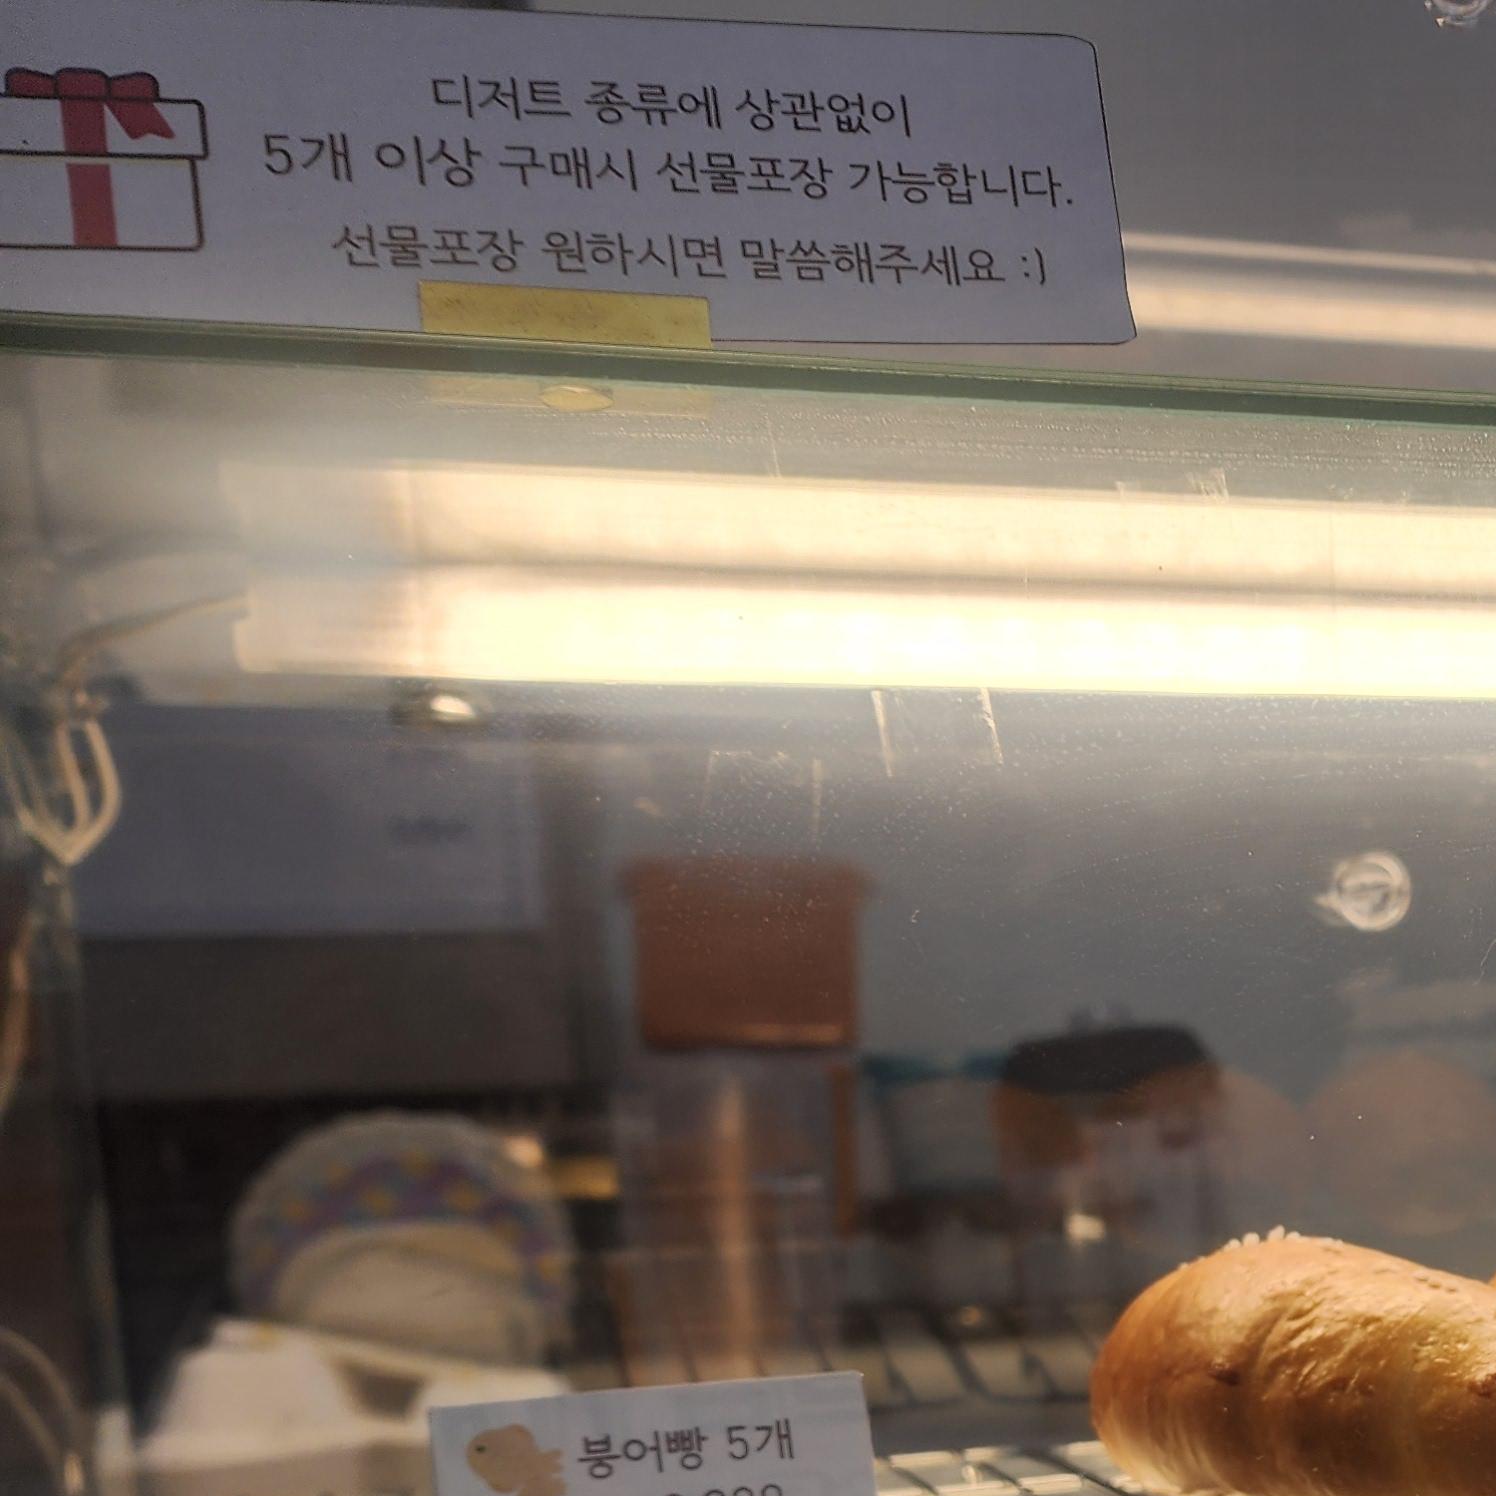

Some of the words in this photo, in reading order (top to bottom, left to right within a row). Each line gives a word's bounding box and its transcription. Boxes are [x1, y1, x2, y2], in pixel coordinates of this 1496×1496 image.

[431, 74, 572, 121] 디저트
[583, 80, 722, 130] 종류에
[735, 88, 912, 137] 상관없이
[263, 133, 353, 183] 5개
[375, 136, 482, 188] 이상
[498, 144, 638, 192] 구매시
[656, 150, 833, 200] 선물포장
[848, 160, 1074, 208] 가능합니다.
[331, 223, 525, 273] 선물포장
[541, 230, 727, 278] 원하시면
[740, 238, 1006, 287] 말씀해주세요
[577, 1426, 708, 1480] 붕어빵
[725, 1418, 795, 1462] 5개
